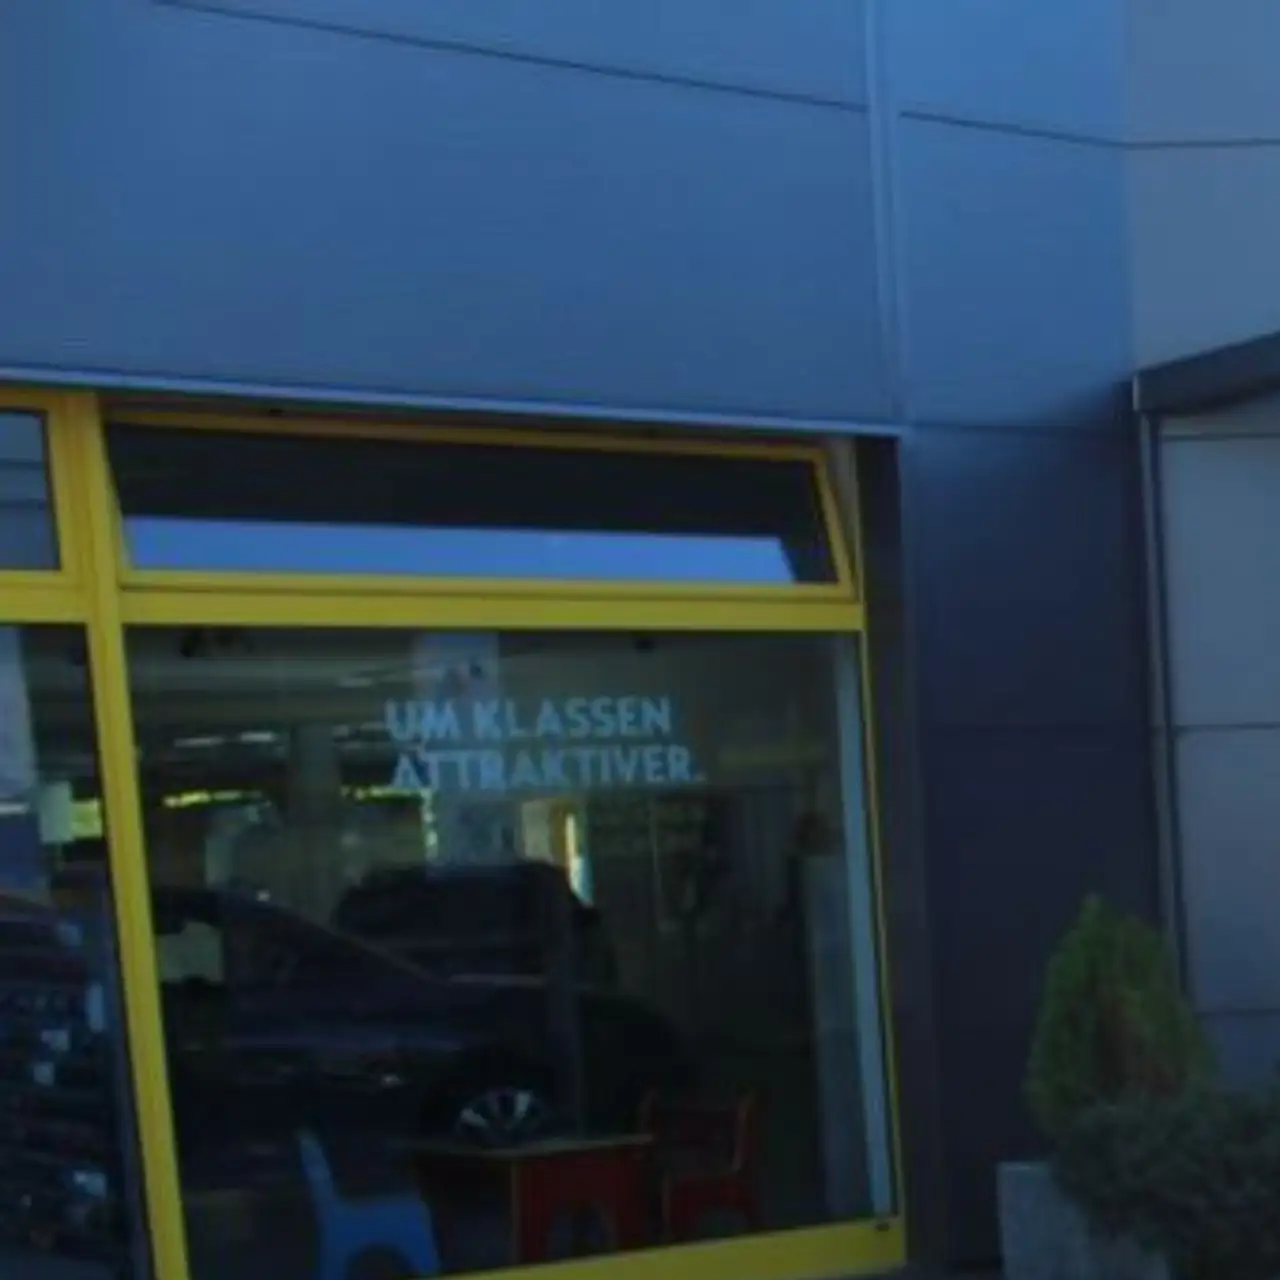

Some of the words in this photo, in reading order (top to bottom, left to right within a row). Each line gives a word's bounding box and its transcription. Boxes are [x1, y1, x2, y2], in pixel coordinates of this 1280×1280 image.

[386, 699, 459, 741] UM
[472, 696, 673, 739] KLASSEN
[390, 744, 706, 791] ATTRAKTIVER.
